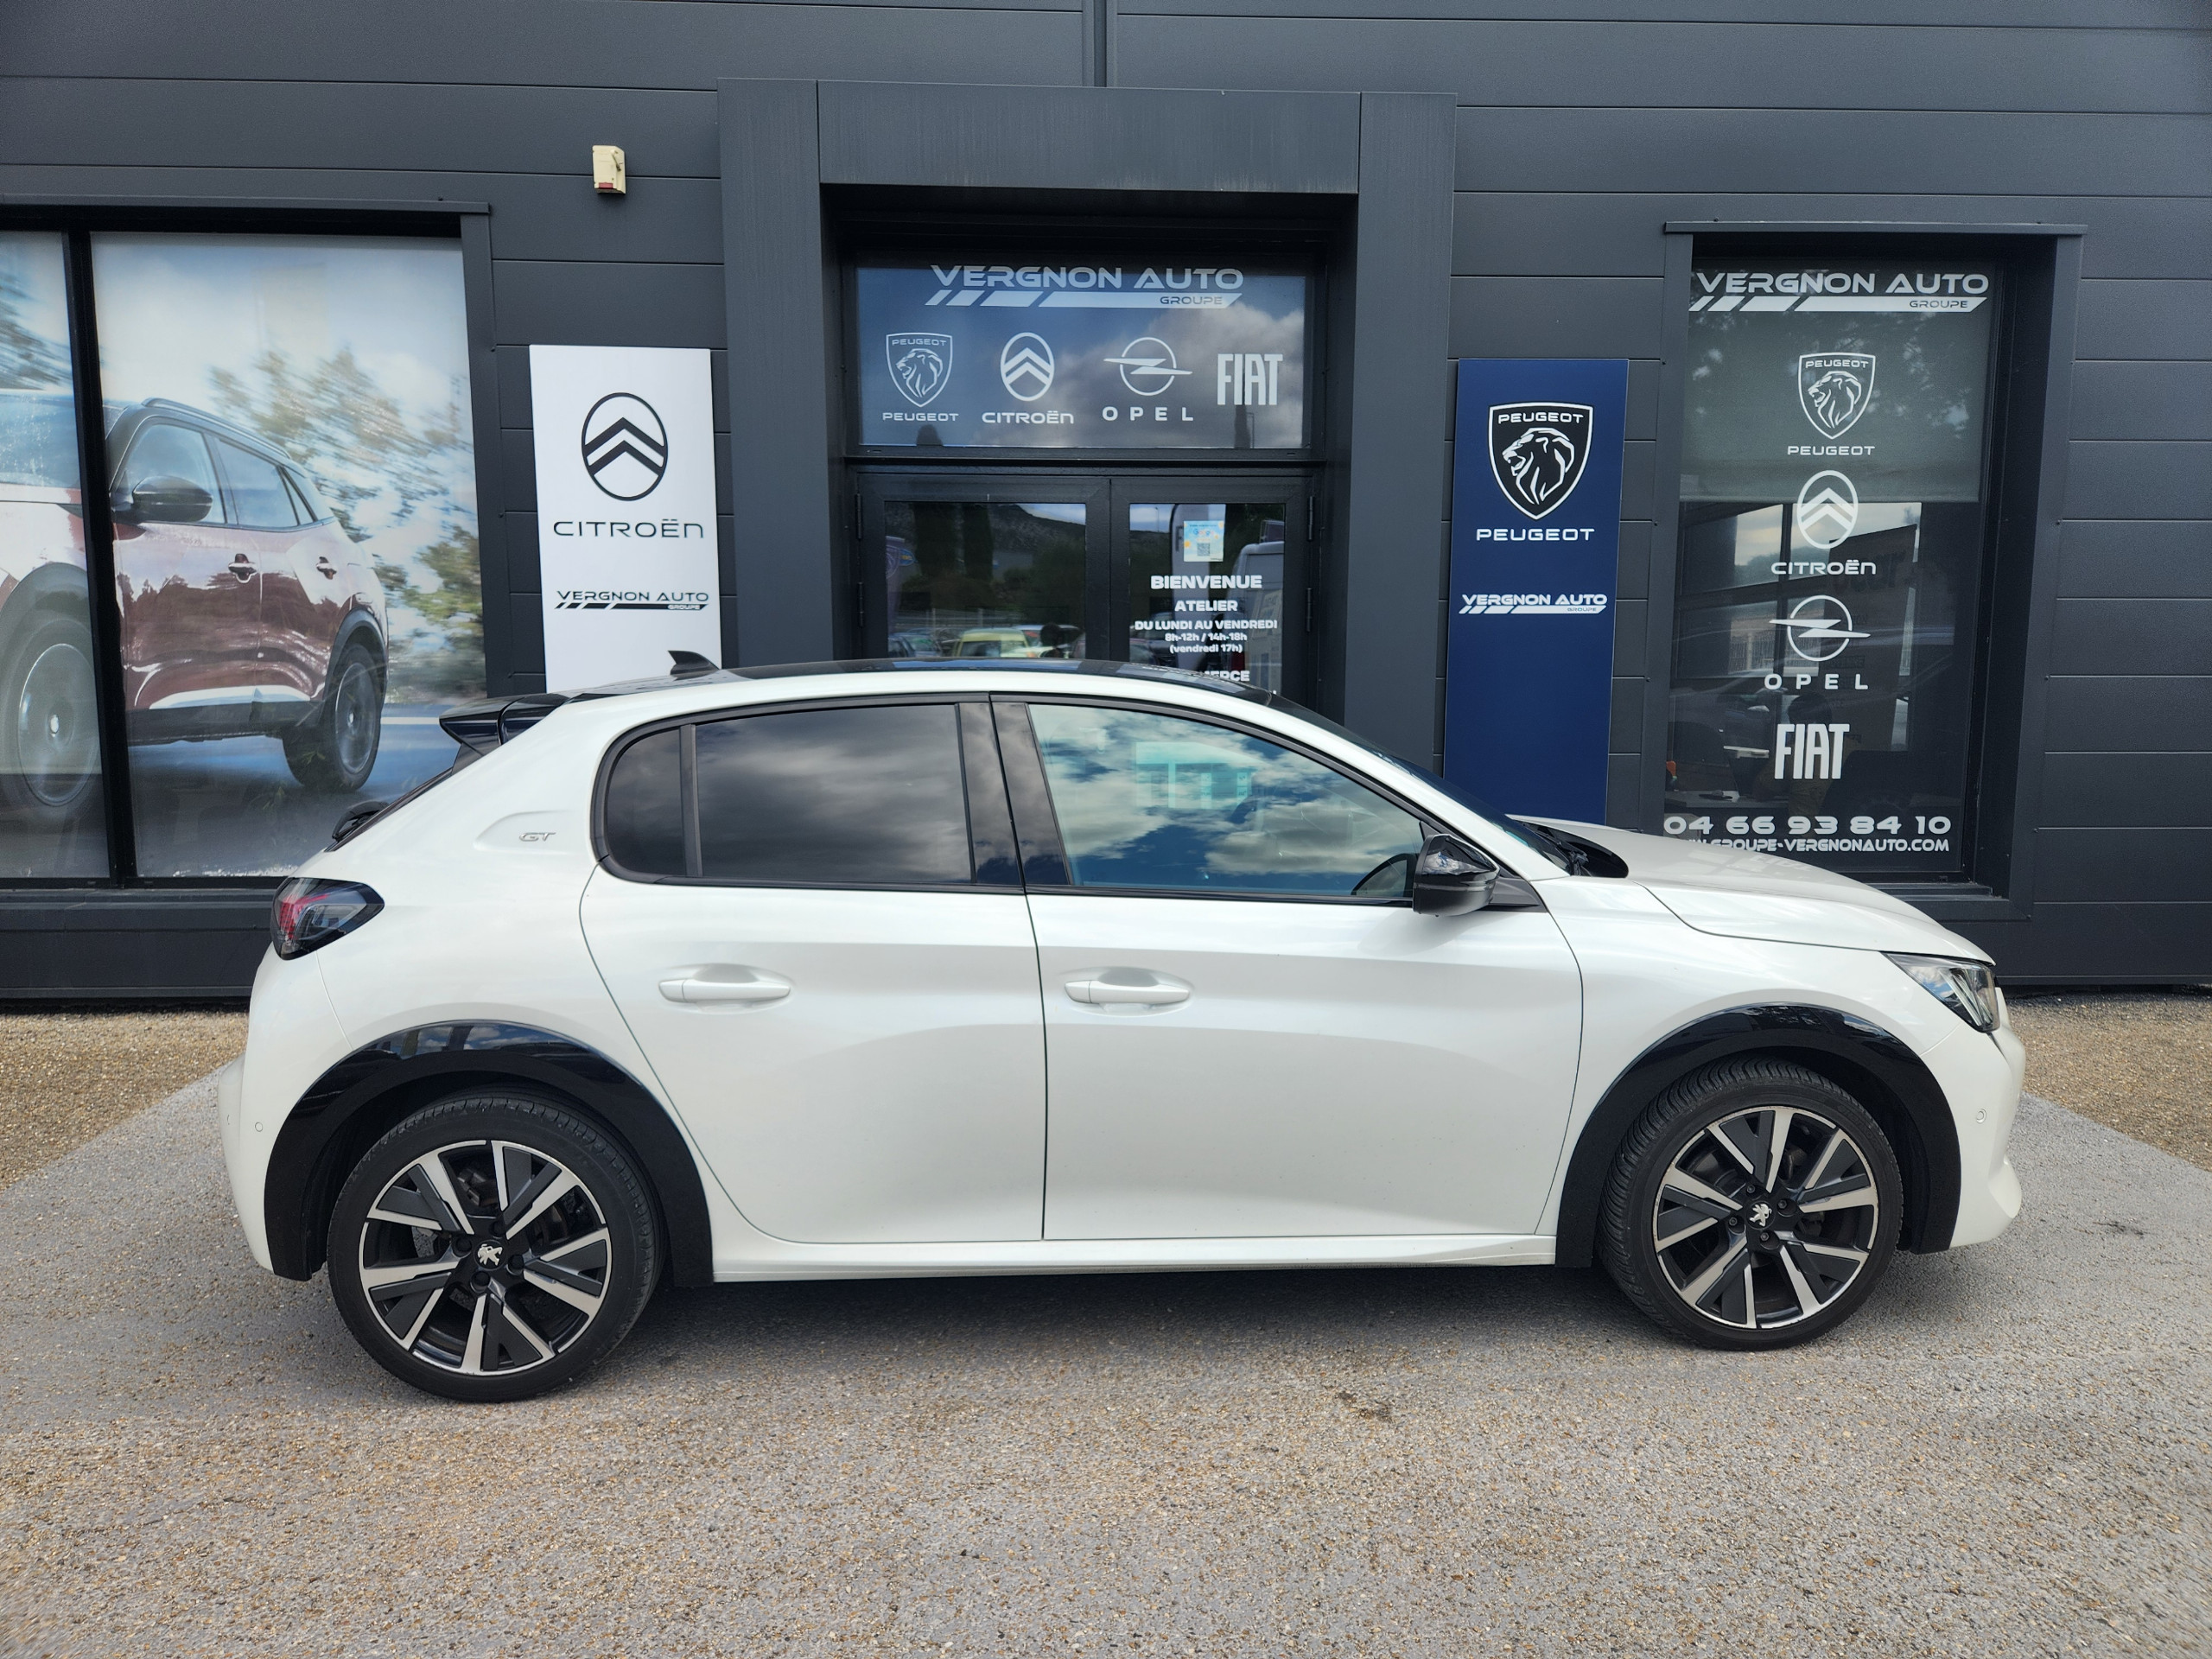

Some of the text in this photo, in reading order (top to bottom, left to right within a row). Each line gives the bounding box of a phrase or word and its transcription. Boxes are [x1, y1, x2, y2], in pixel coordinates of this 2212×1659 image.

[931, 264, 1244, 290] VERGNON AUTO
[1696, 272, 1989, 294] VERGNON AUTO
[1160, 296, 1223, 305] GROUPE
[1910, 300, 1968, 308] GROUPE
[1805, 359, 1869, 368] PEUGEOT
[1217, 353, 1283, 405] FIAT
[882, 412, 958, 422] PEUGEOT
[1102, 406, 1193, 422] OPEL
[1497, 411, 1584, 424] PEUGEOT
[1787, 446, 1875, 455] PEUGEOT
[1476, 528, 1595, 541] PEUGEOT
[1150, 575, 1263, 589] BIENVENUE
[557, 591, 709, 602] VERGNON AUTO
[1462, 594, 1608, 606] VERGNON AUTO
[1174, 600, 1238, 612] ATELIER
[1135, 620, 1278, 631] DU LUNDI AU VENDREDI
[1165, 632, 1199, 641] 8h-12h
[1208, 632, 1248, 641] 14h-18h
[1169, 644, 1243, 654] (vendredi 17h)
[1764, 673, 1868, 690] OPEL
[1774, 723, 1850, 779] FIAT
[1663, 816, 1951, 835] 04 66 93 84 10
[519, 832, 556, 842] GT
[1686, 838, 1950, 853] GROUPE-VERGNONAUTO.COM
